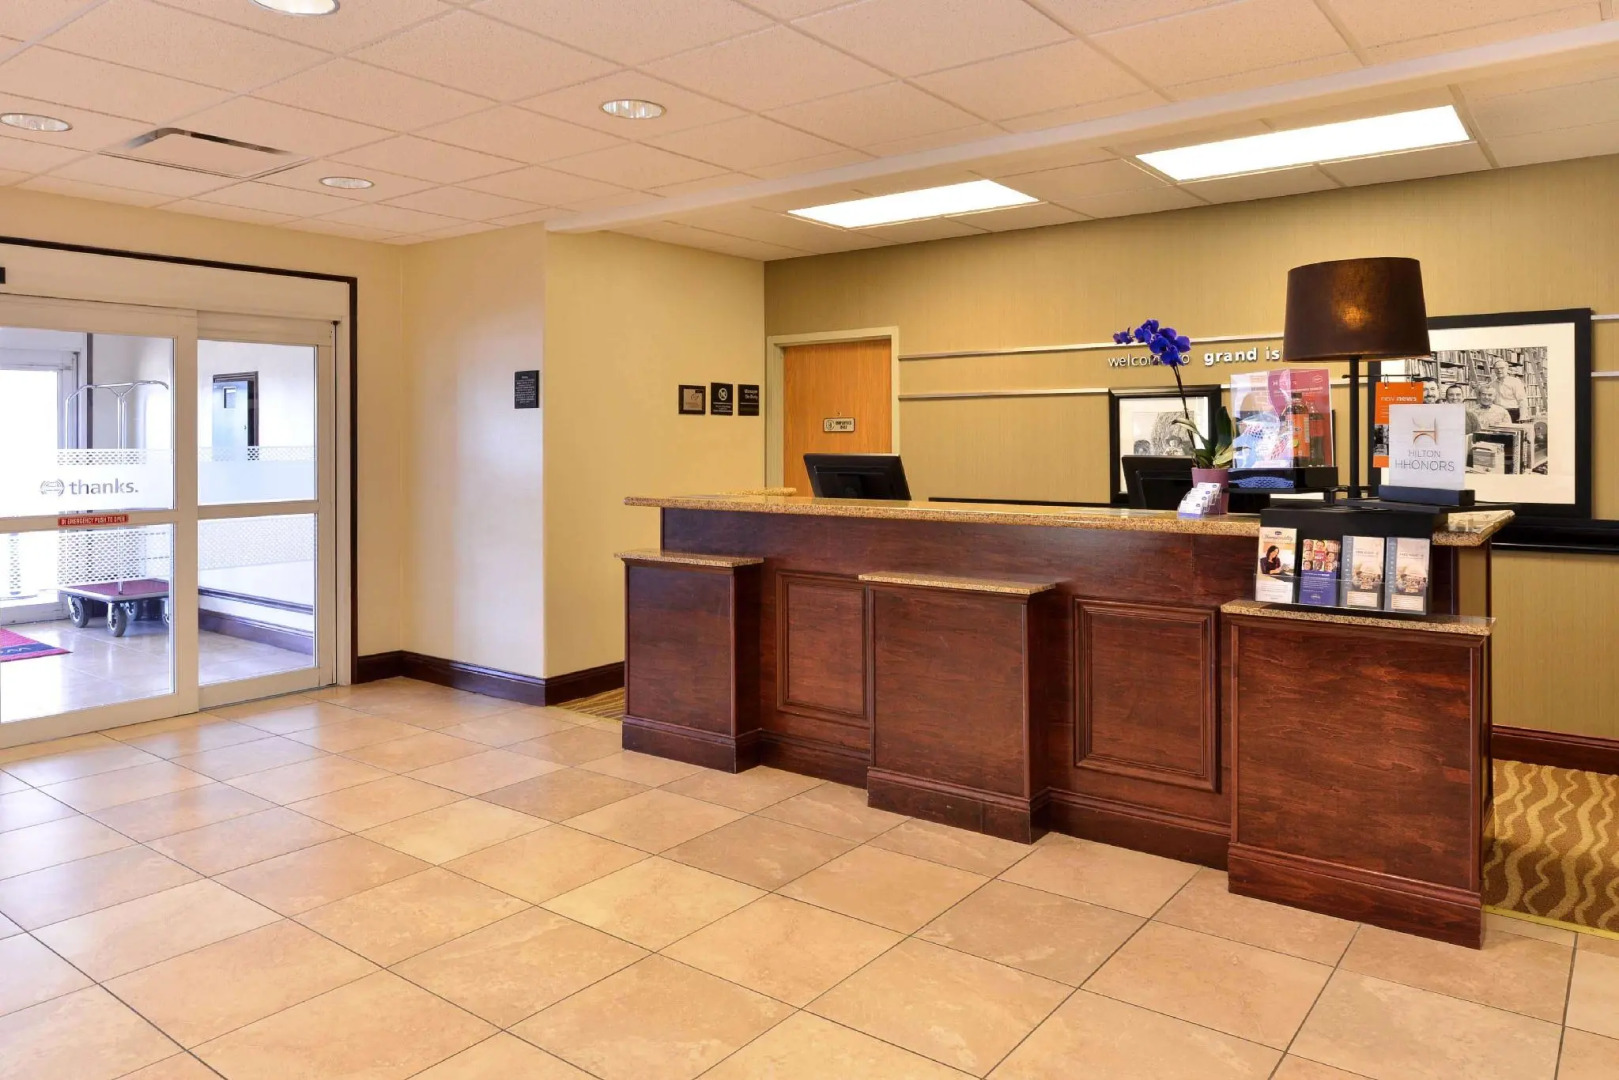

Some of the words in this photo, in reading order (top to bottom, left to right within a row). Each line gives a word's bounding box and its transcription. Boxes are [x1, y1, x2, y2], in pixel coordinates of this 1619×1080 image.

[1204, 347, 1257, 366] grand
[1408, 449, 1441, 458] HILTON
[1394, 459, 1455, 472] HHONORS
[69, 478, 139, 495] thanks.
[67, 517, 94, 525] EMERGENCY
